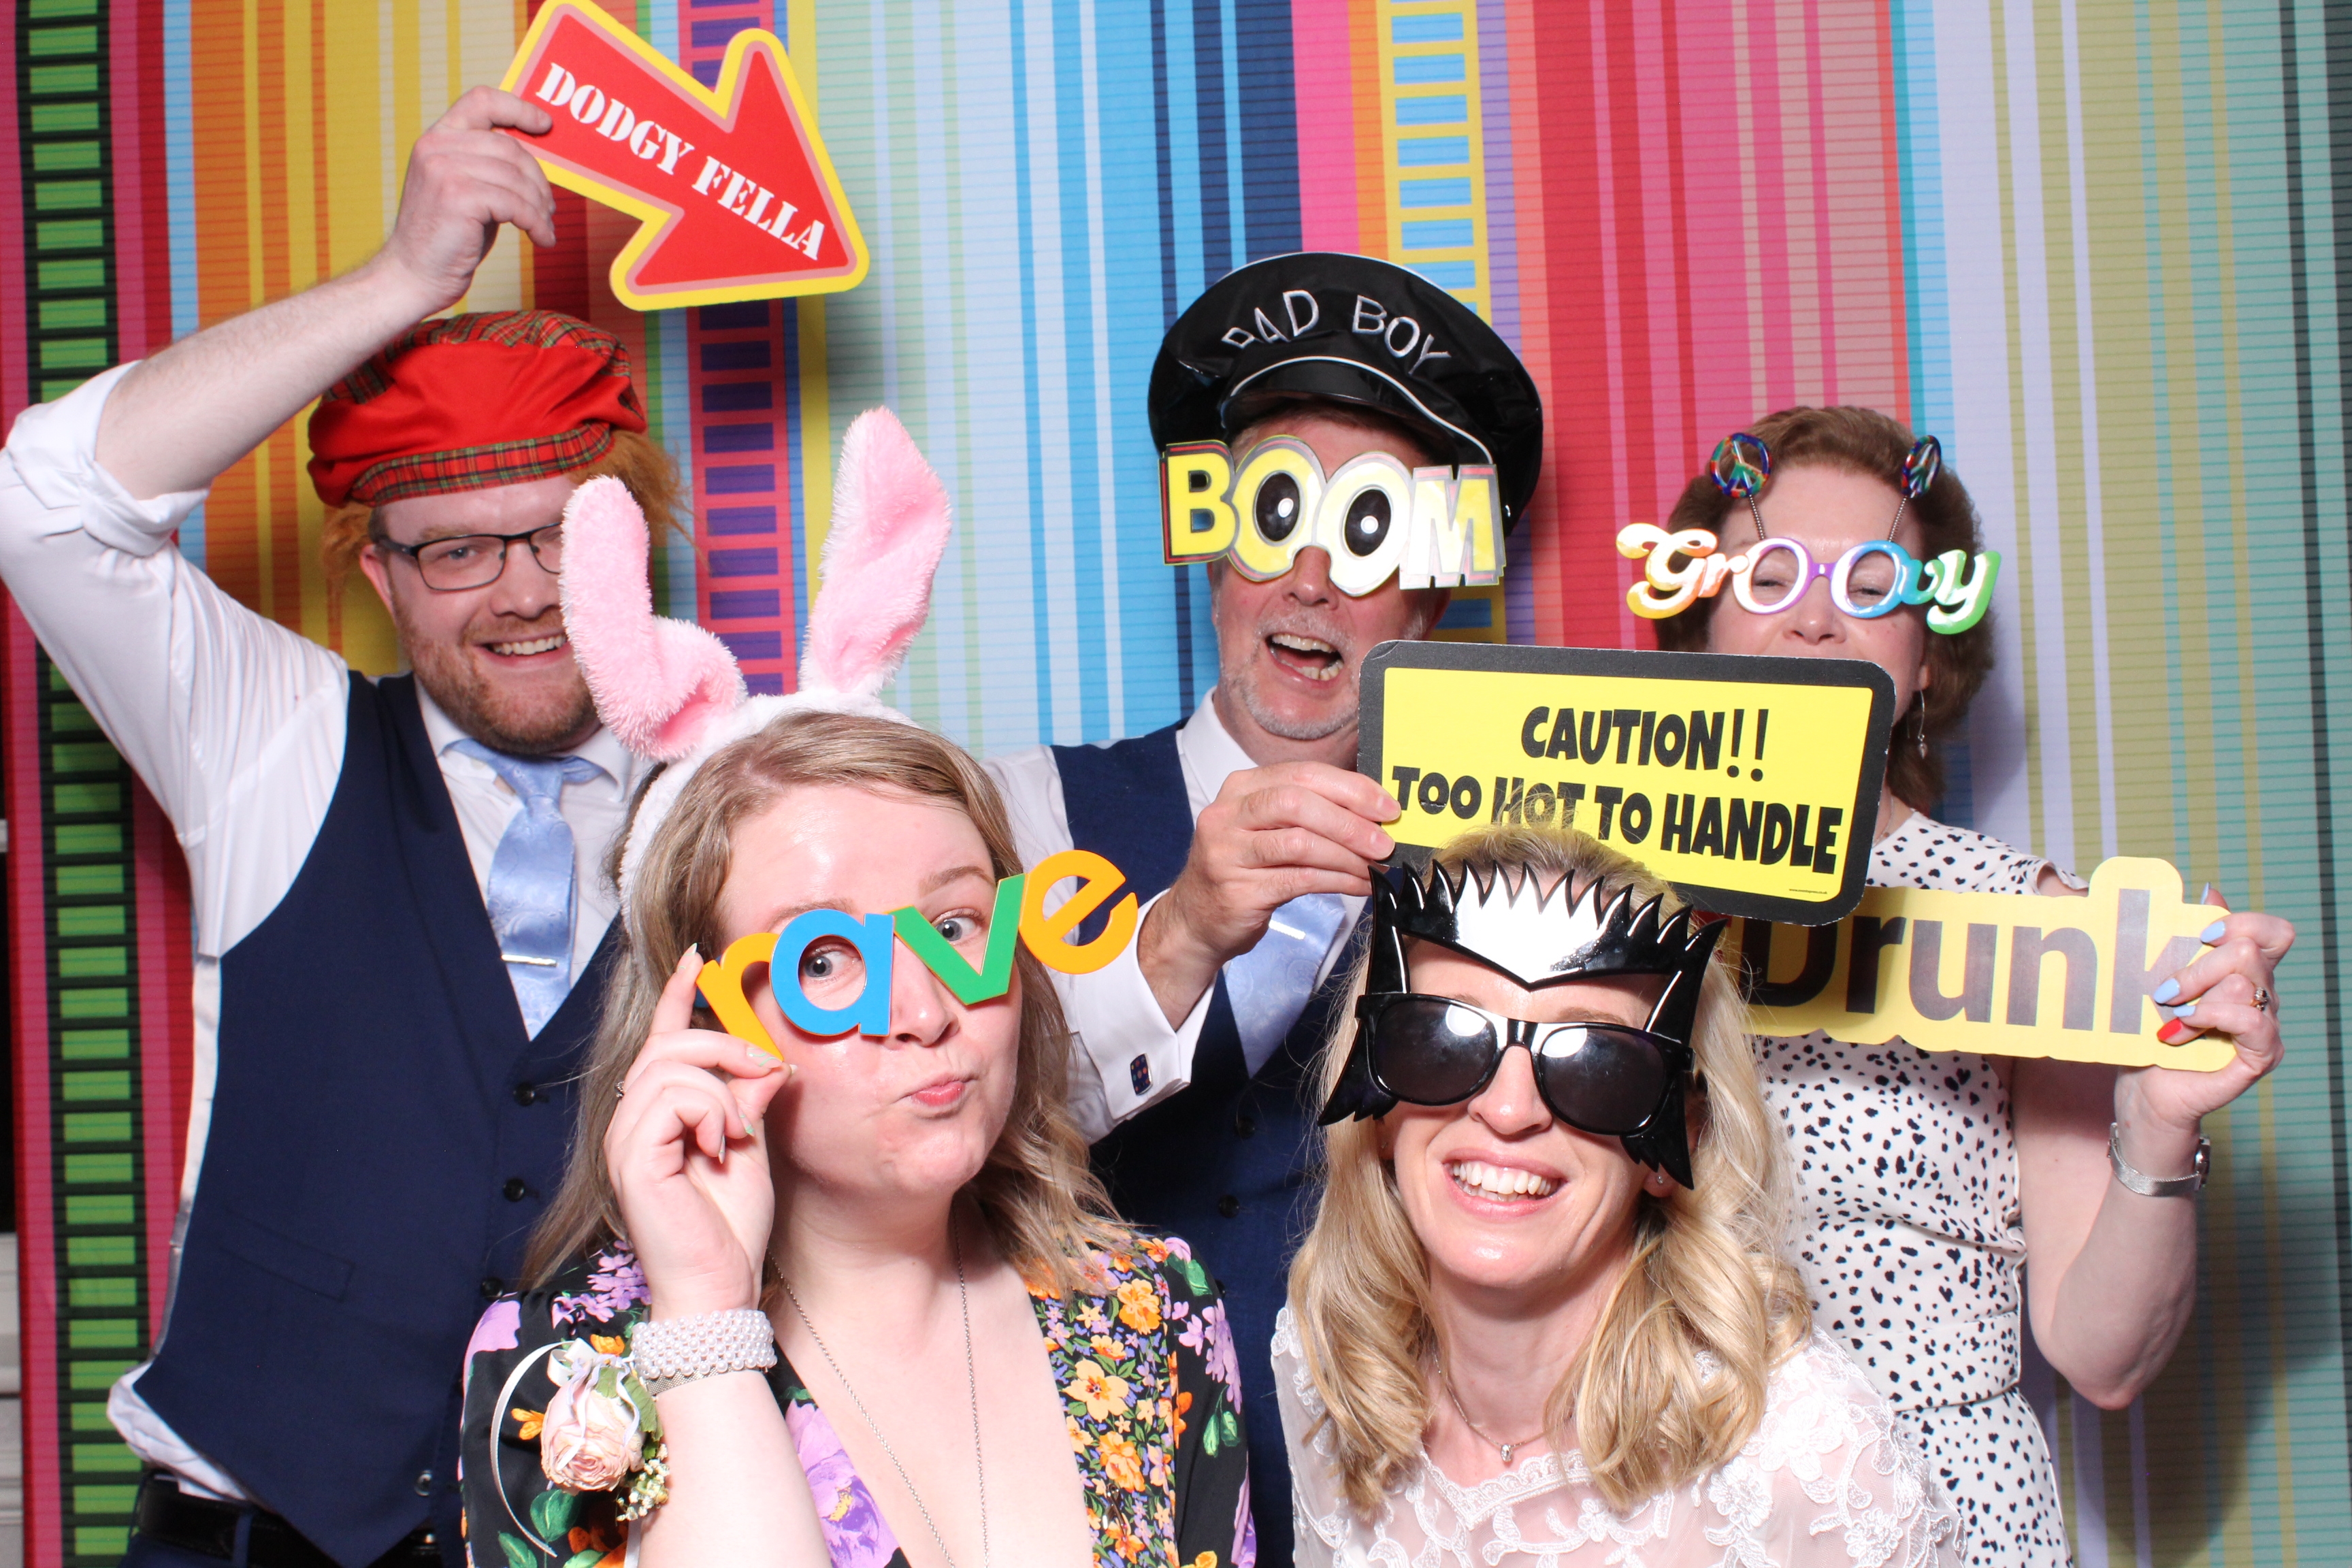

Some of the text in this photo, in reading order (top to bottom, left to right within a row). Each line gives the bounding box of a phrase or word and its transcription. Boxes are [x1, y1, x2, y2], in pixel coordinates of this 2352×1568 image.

[536, 63, 825, 260] DODGY FELLA
[1352, 295, 1452, 375] BOY
[1160, 435, 1506, 597] BOOM
[1521, 706, 1769, 782] CAUTION!!
[1392, 766, 1844, 875] TOO HOT TO HANDLE
[696, 849, 1138, 1062] rave
[1737, 889, 2206, 1034] Drunk
